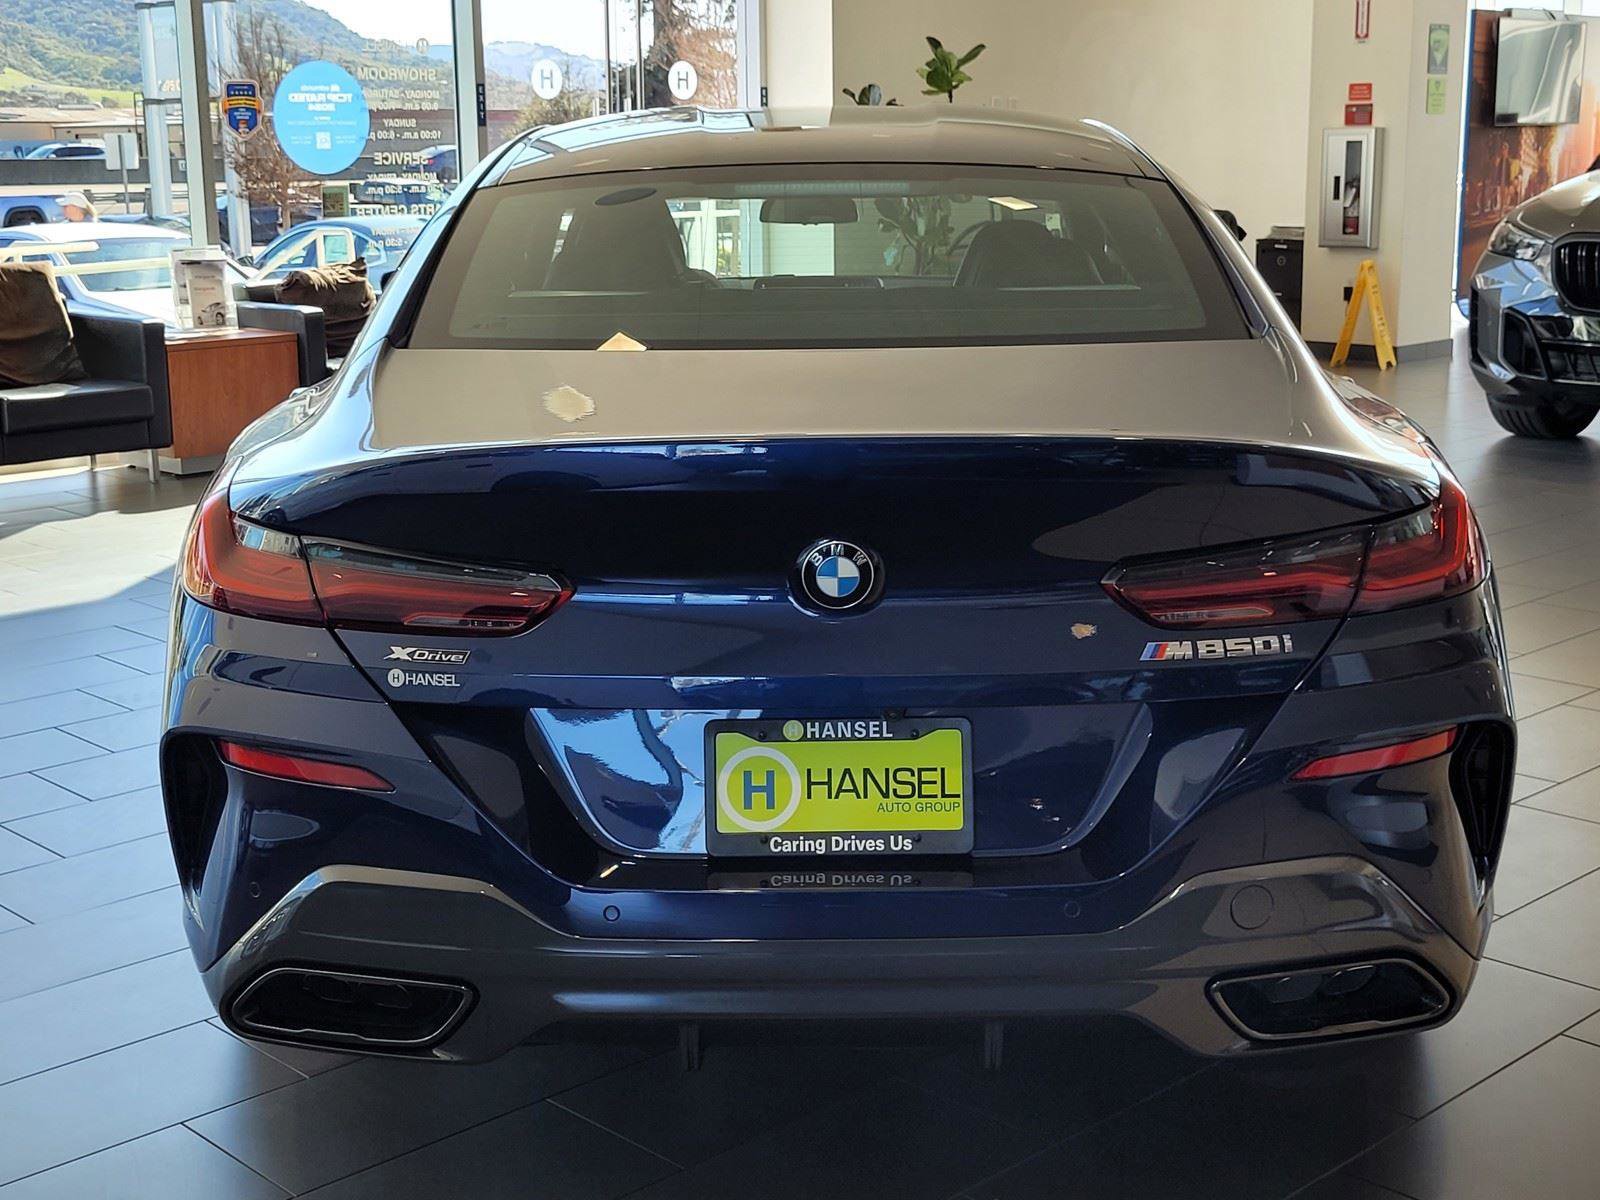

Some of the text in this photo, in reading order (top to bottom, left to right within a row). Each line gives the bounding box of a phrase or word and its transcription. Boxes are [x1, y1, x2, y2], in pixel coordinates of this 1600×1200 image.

[405, 672, 460, 687] HANSEL
[806, 721, 893, 739] HANSEL
[742, 767, 961, 810] H HANSEL
[876, 801, 961, 813] AUTO GROUP
[769, 834, 913, 854] Caring Drives Us
